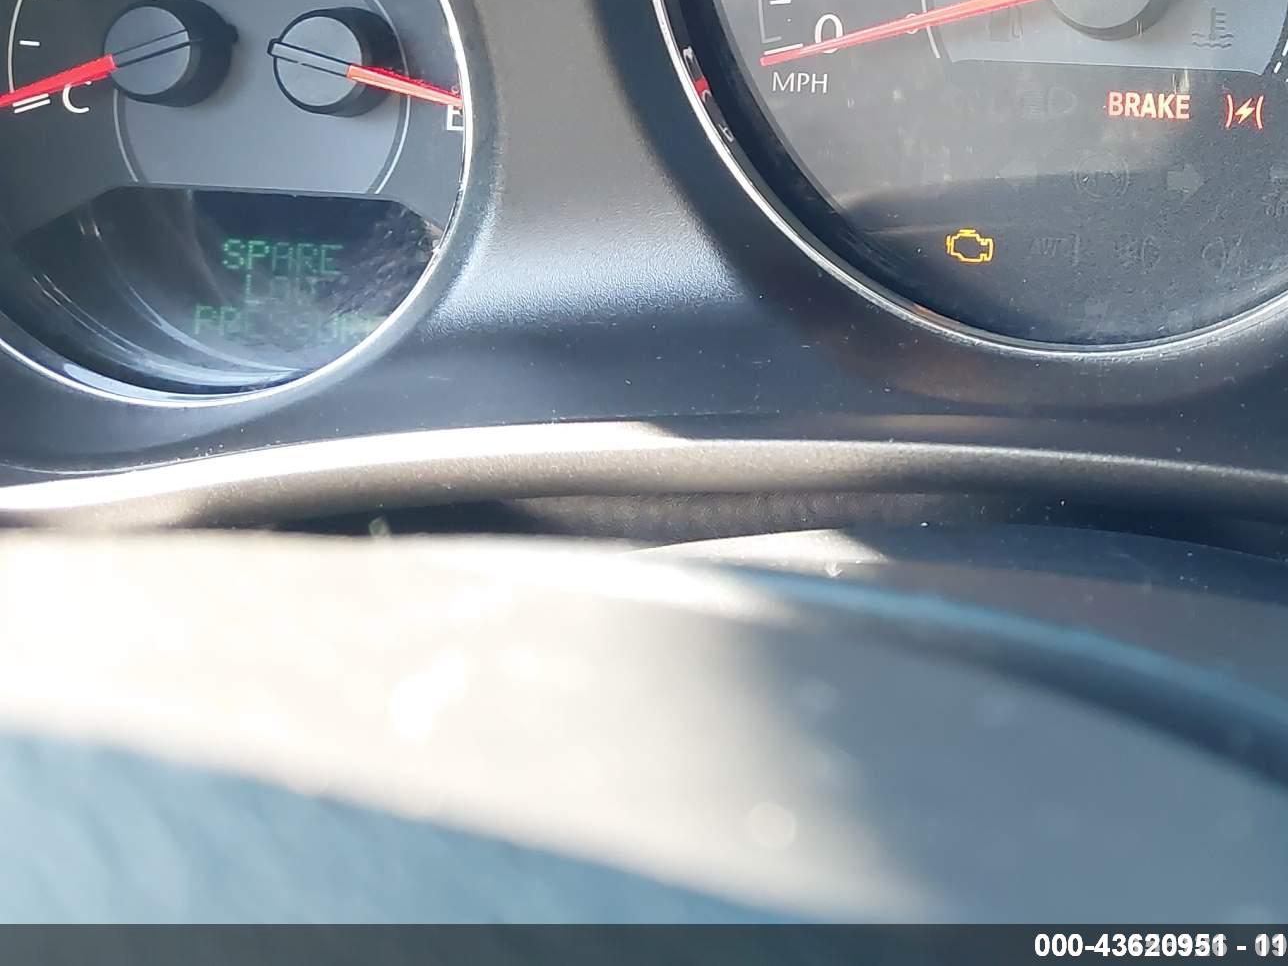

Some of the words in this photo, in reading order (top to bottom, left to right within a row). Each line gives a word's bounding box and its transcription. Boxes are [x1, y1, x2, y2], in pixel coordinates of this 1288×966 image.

[814, 14, 844, 53] 0
[772, 72, 829, 94] MPH
[1108, 91, 1192, 121] BRAKE
[222, 238, 345, 276] SPARE
